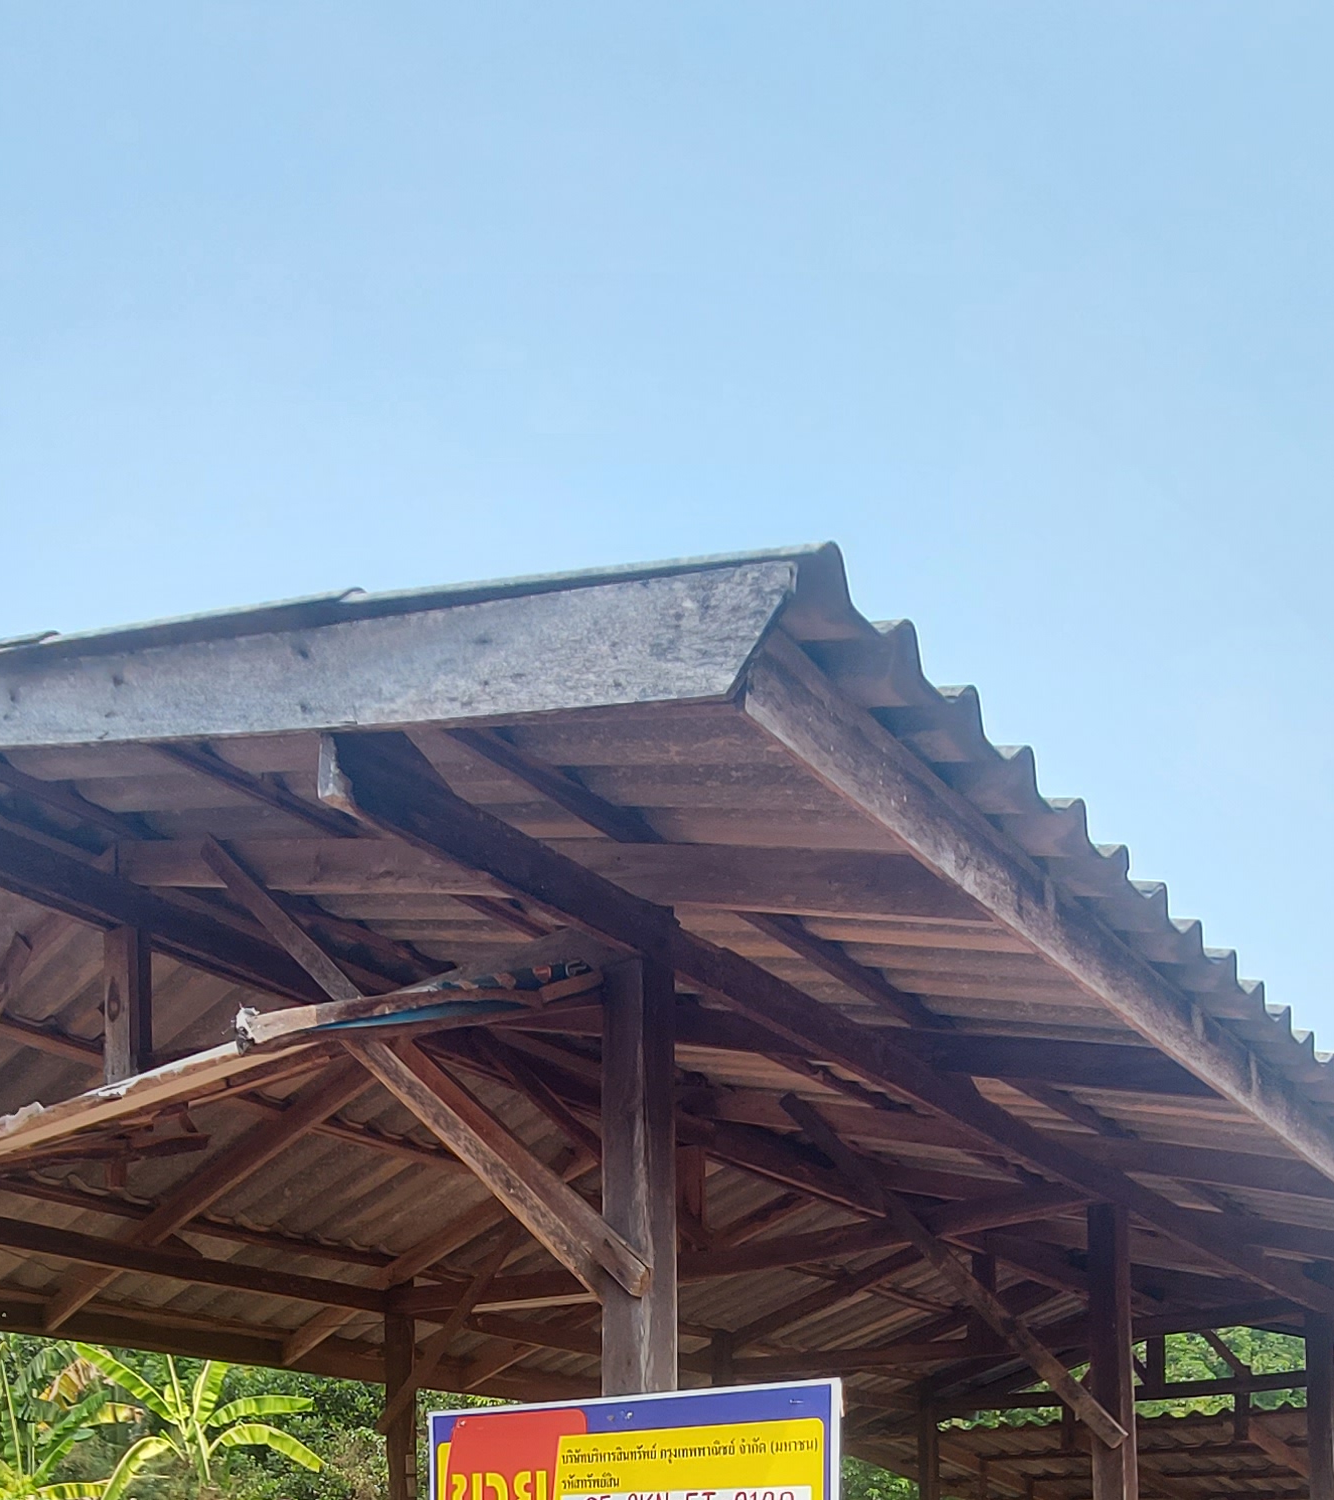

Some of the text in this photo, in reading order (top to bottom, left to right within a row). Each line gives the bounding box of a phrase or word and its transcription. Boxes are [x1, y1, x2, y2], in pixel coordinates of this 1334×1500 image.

[738, 1437, 766, 1455] จำกัด
[770, 1437, 818, 1455] (มหาชน)
[561, 1473, 620, 1489] รหัสทรัพย์สิน
